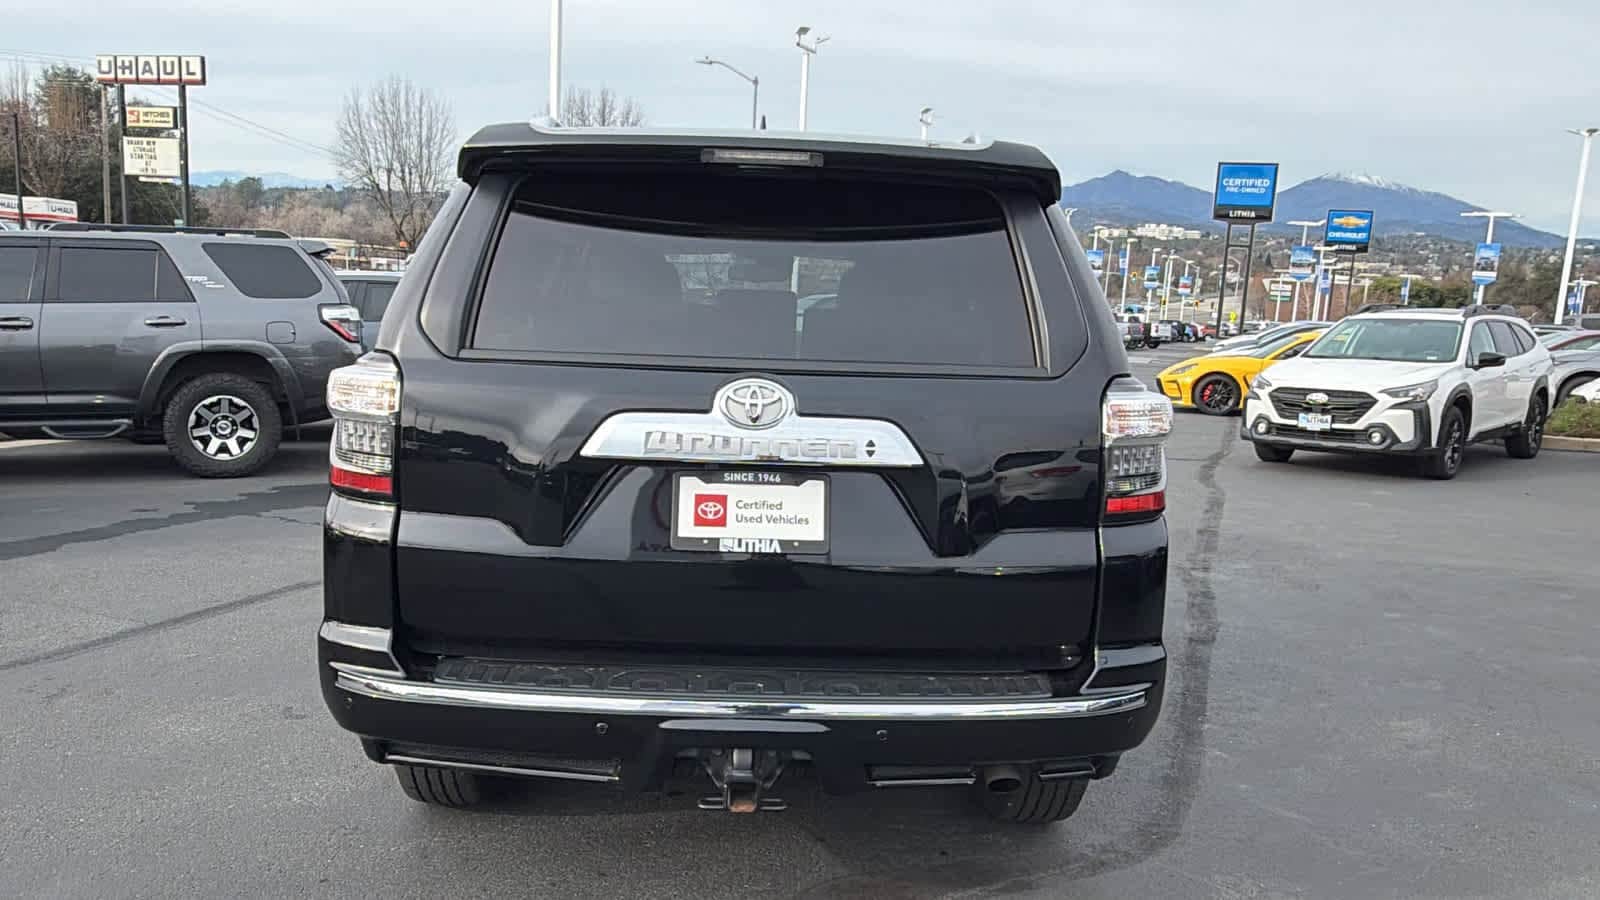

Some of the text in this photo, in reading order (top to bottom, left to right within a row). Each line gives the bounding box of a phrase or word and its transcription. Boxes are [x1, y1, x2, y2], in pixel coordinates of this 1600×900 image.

[1223, 178, 1270, 187] CERTIFIED
[1229, 210, 1256, 218] LITHIA
[1328, 231, 1368, 239] CHEVROLET
[723, 472, 781, 483] SINCE 1946
[736, 499, 783, 511] Certified
[736, 513, 809, 526] Used Vehicles
[734, 539, 782, 553] LITHIA
